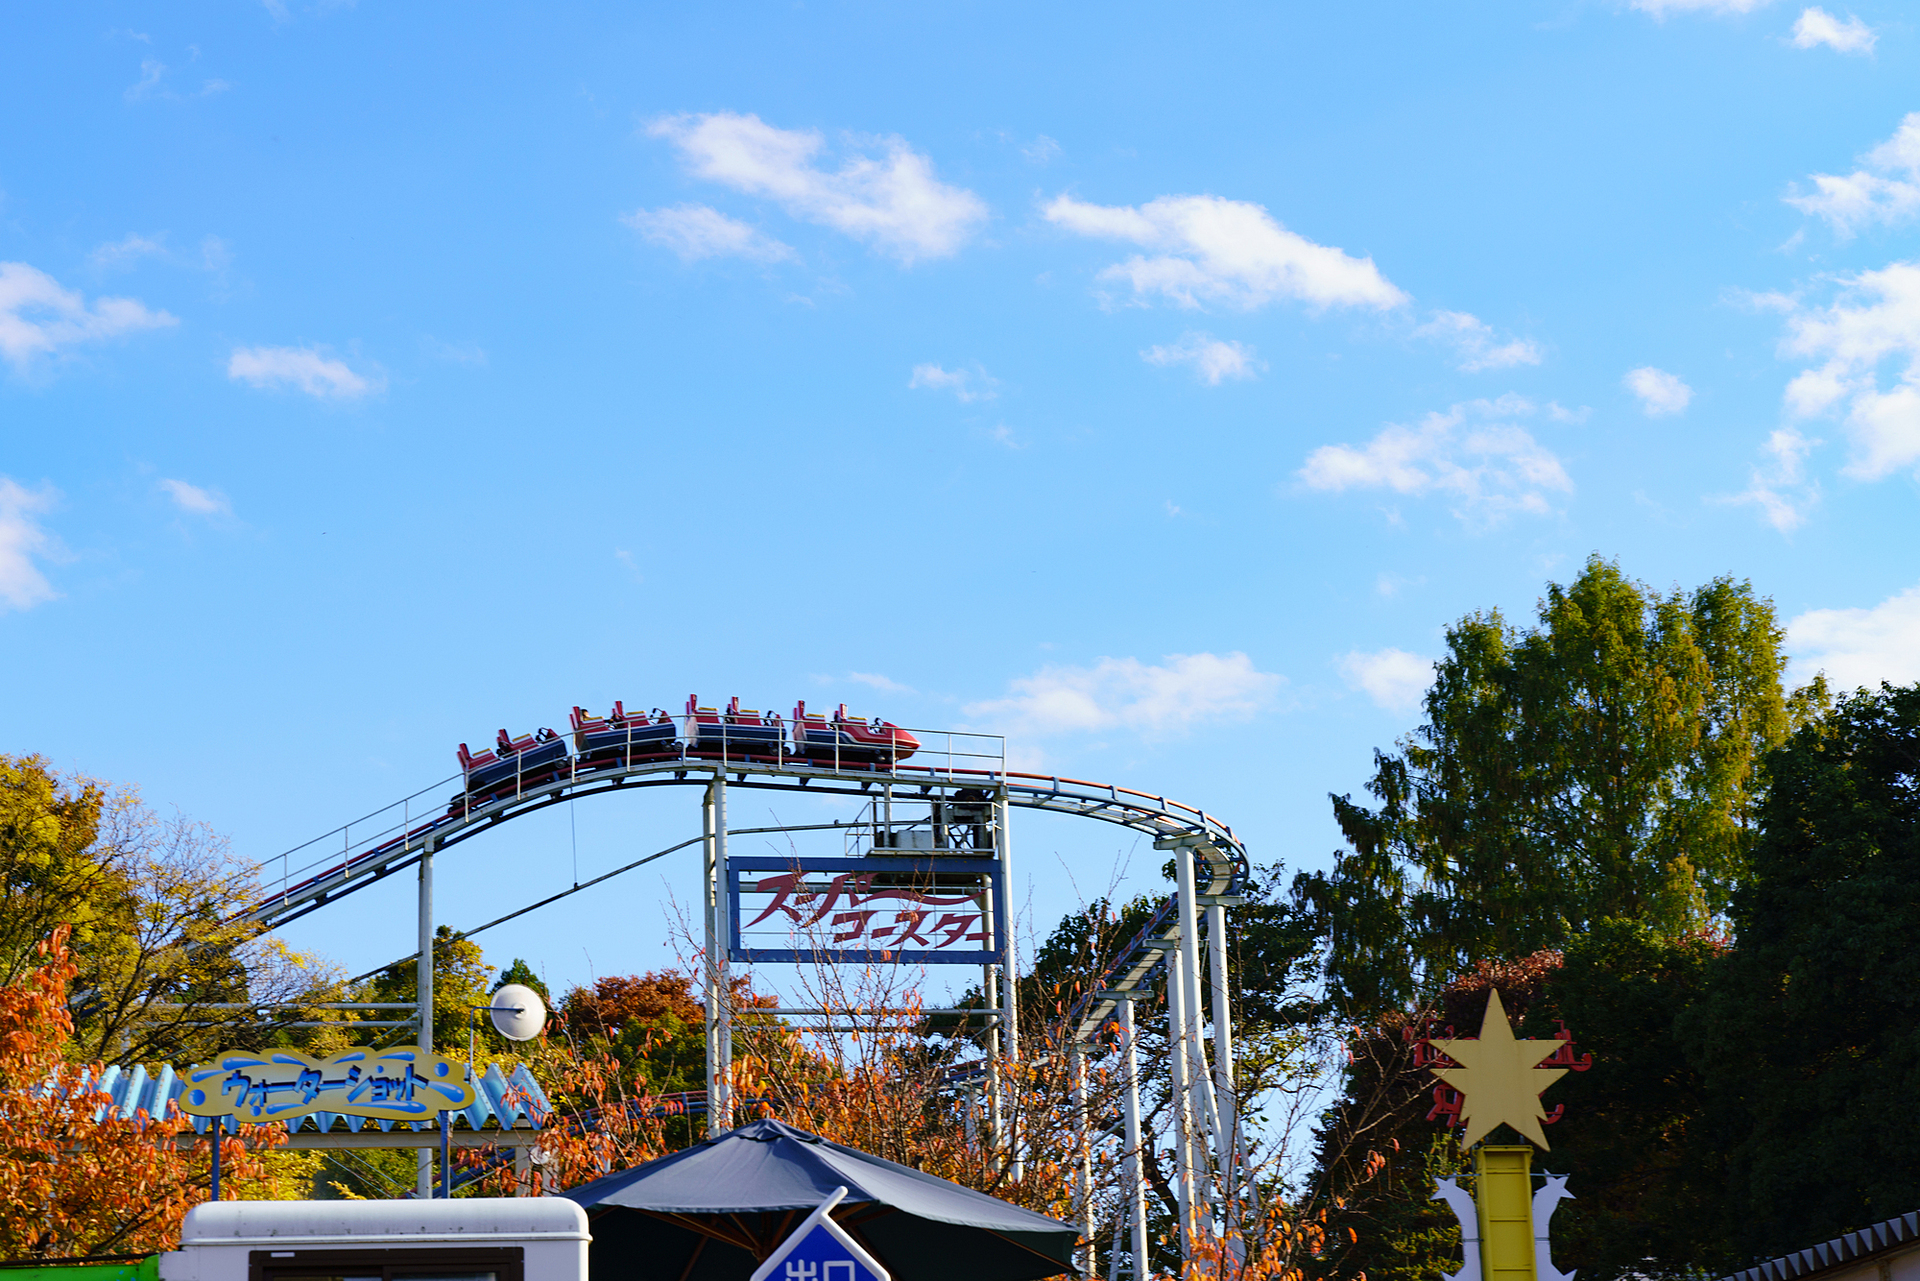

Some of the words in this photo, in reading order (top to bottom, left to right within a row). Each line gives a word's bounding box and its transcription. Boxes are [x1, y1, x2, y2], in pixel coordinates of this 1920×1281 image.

[743, 872, 990, 929] スーパー
[831, 910, 991, 949] コースター
[221, 1064, 428, 1108] ウォーターショット
